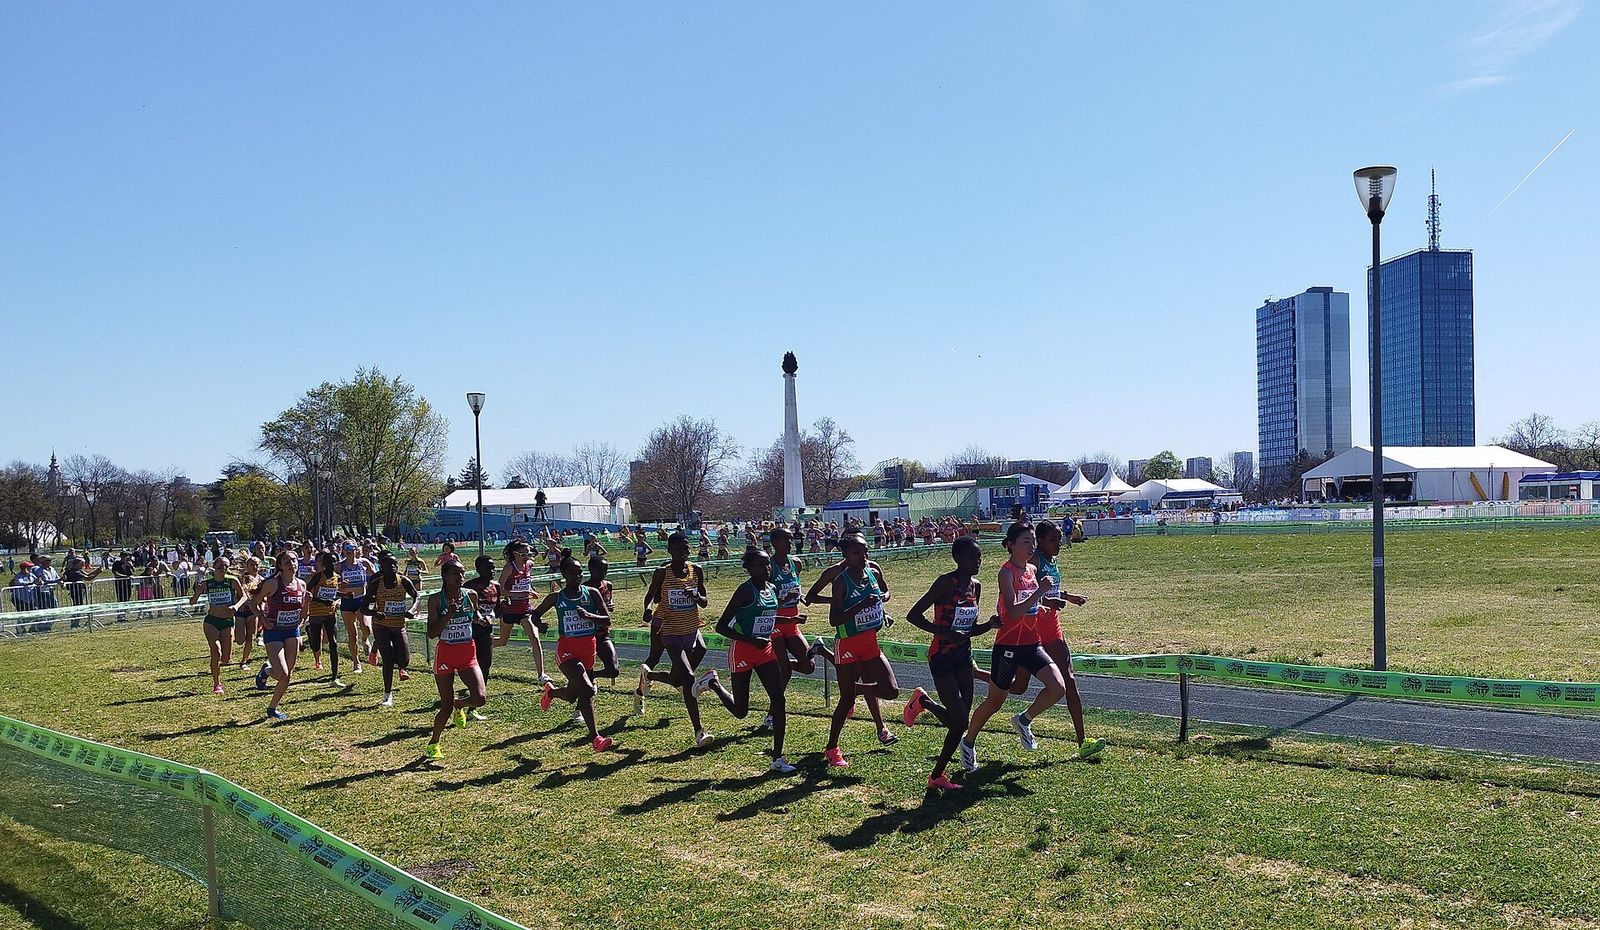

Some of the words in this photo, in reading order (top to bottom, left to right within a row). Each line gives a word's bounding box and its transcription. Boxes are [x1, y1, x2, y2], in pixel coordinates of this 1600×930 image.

[282, 596, 302, 604] USA
[958, 608, 975, 616] SON
[448, 631, 466, 640] DIDA
